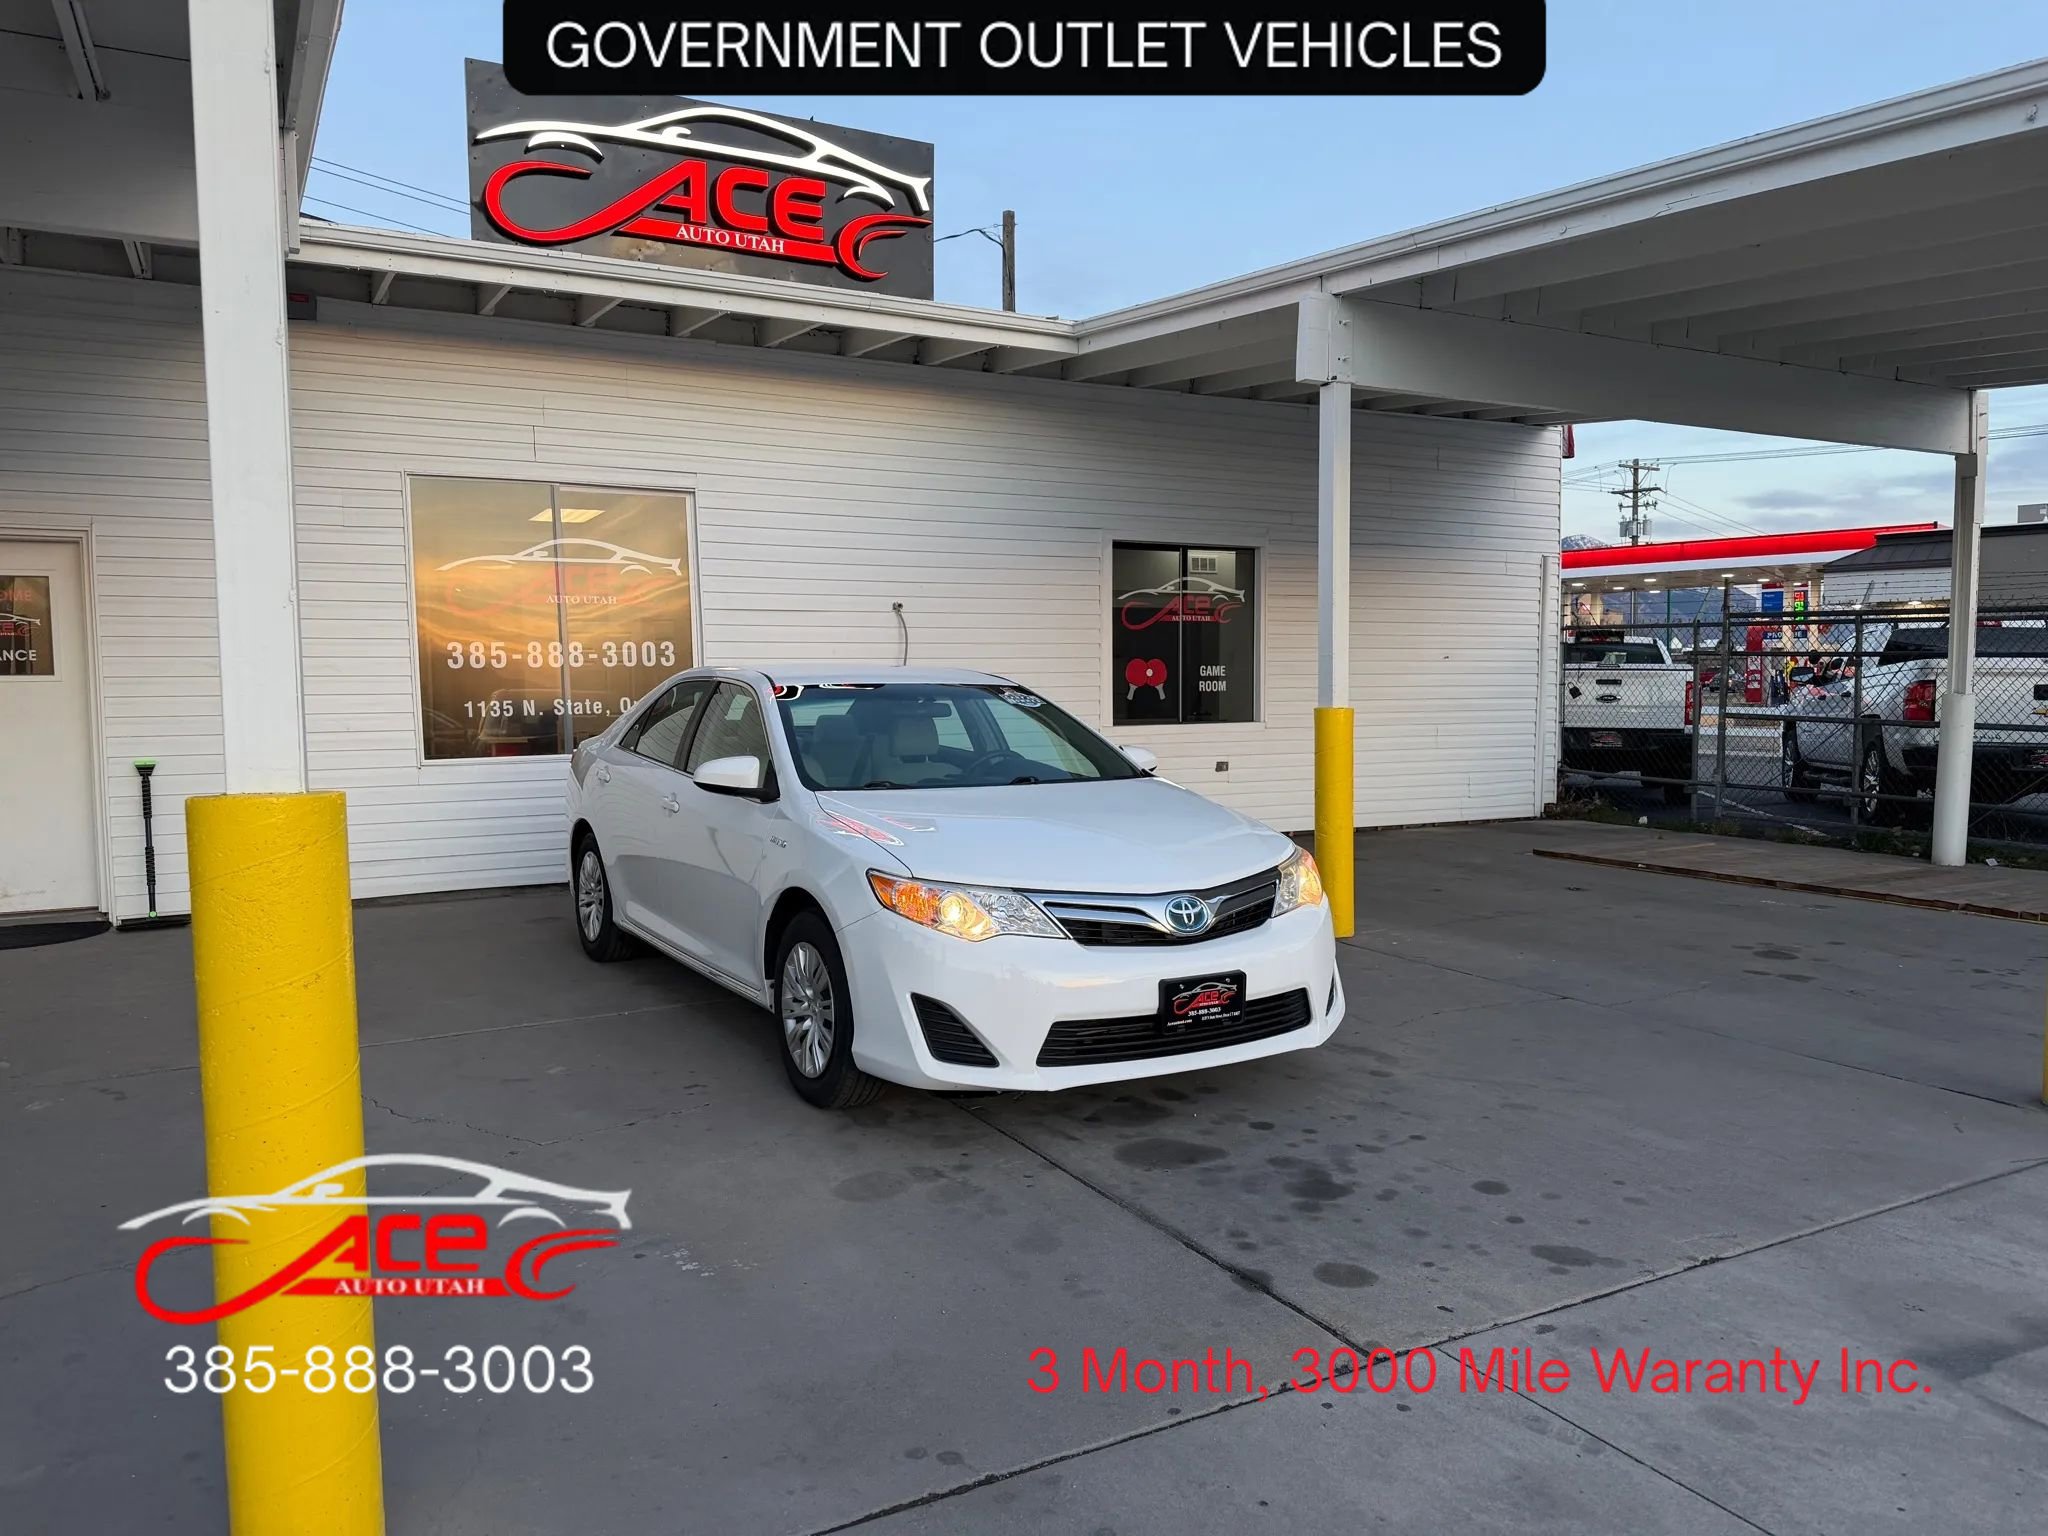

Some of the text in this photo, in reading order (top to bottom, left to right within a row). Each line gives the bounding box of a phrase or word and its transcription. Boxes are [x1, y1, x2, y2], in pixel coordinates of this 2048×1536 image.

[636, 158, 827, 242] ACE
[676, 225, 785, 254] AUTO UTAH
[546, 594, 617, 605] AUTO UTAH
[0, 649, 37, 661] NCE
[446, 640, 676, 669] 385-888-3003
[1199, 665, 1226, 677] GAME
[1199, 680, 1227, 692] ROOM
[464, 699, 514, 718] 1135
[523, 698, 544, 717] N.
[553, 697, 610, 717] State,
